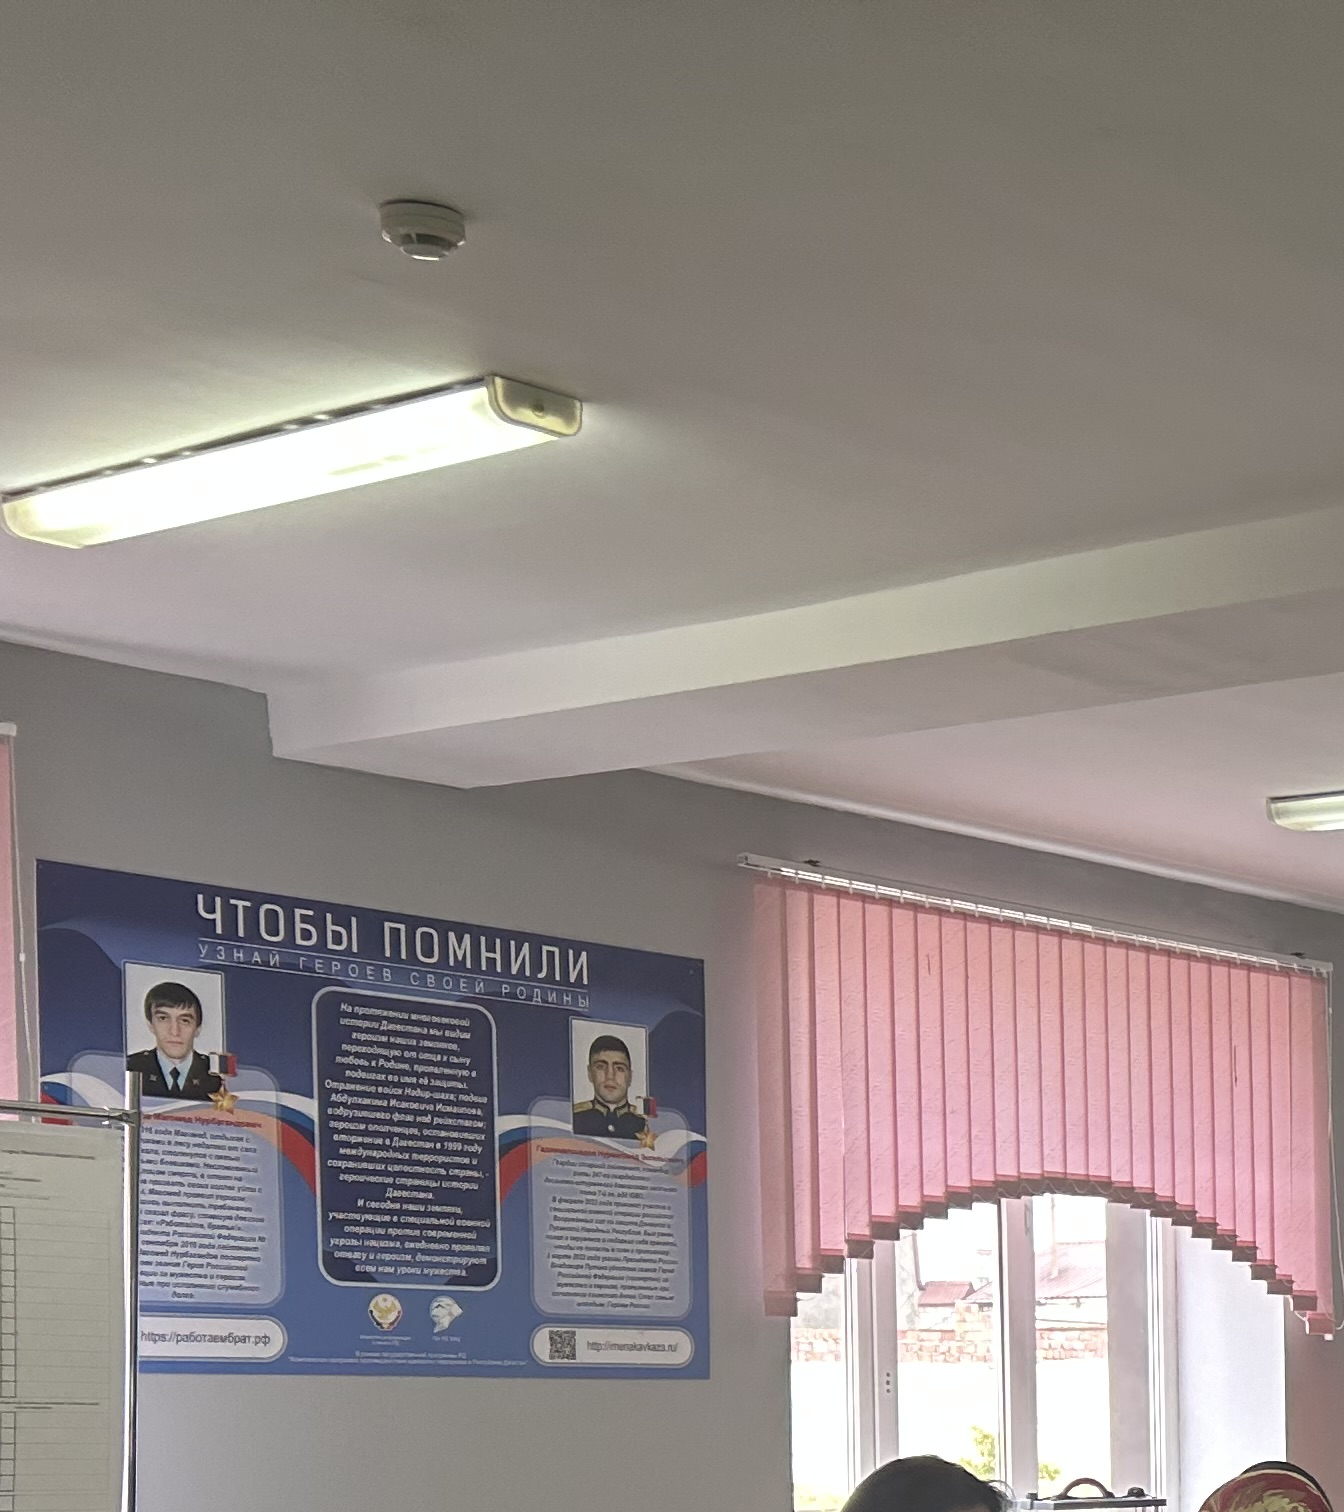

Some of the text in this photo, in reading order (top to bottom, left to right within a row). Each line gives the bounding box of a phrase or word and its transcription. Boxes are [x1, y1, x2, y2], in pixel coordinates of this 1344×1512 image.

[197, 894, 589, 985] ЧТОБЫ ПОМНИЛИ
[198, 943, 589, 1008] УЗНАЙ ГЕРОЕВ СВОЕЙ РОДИНЫ
[140, 1330, 271, 1347] https://работаембрат.рф
